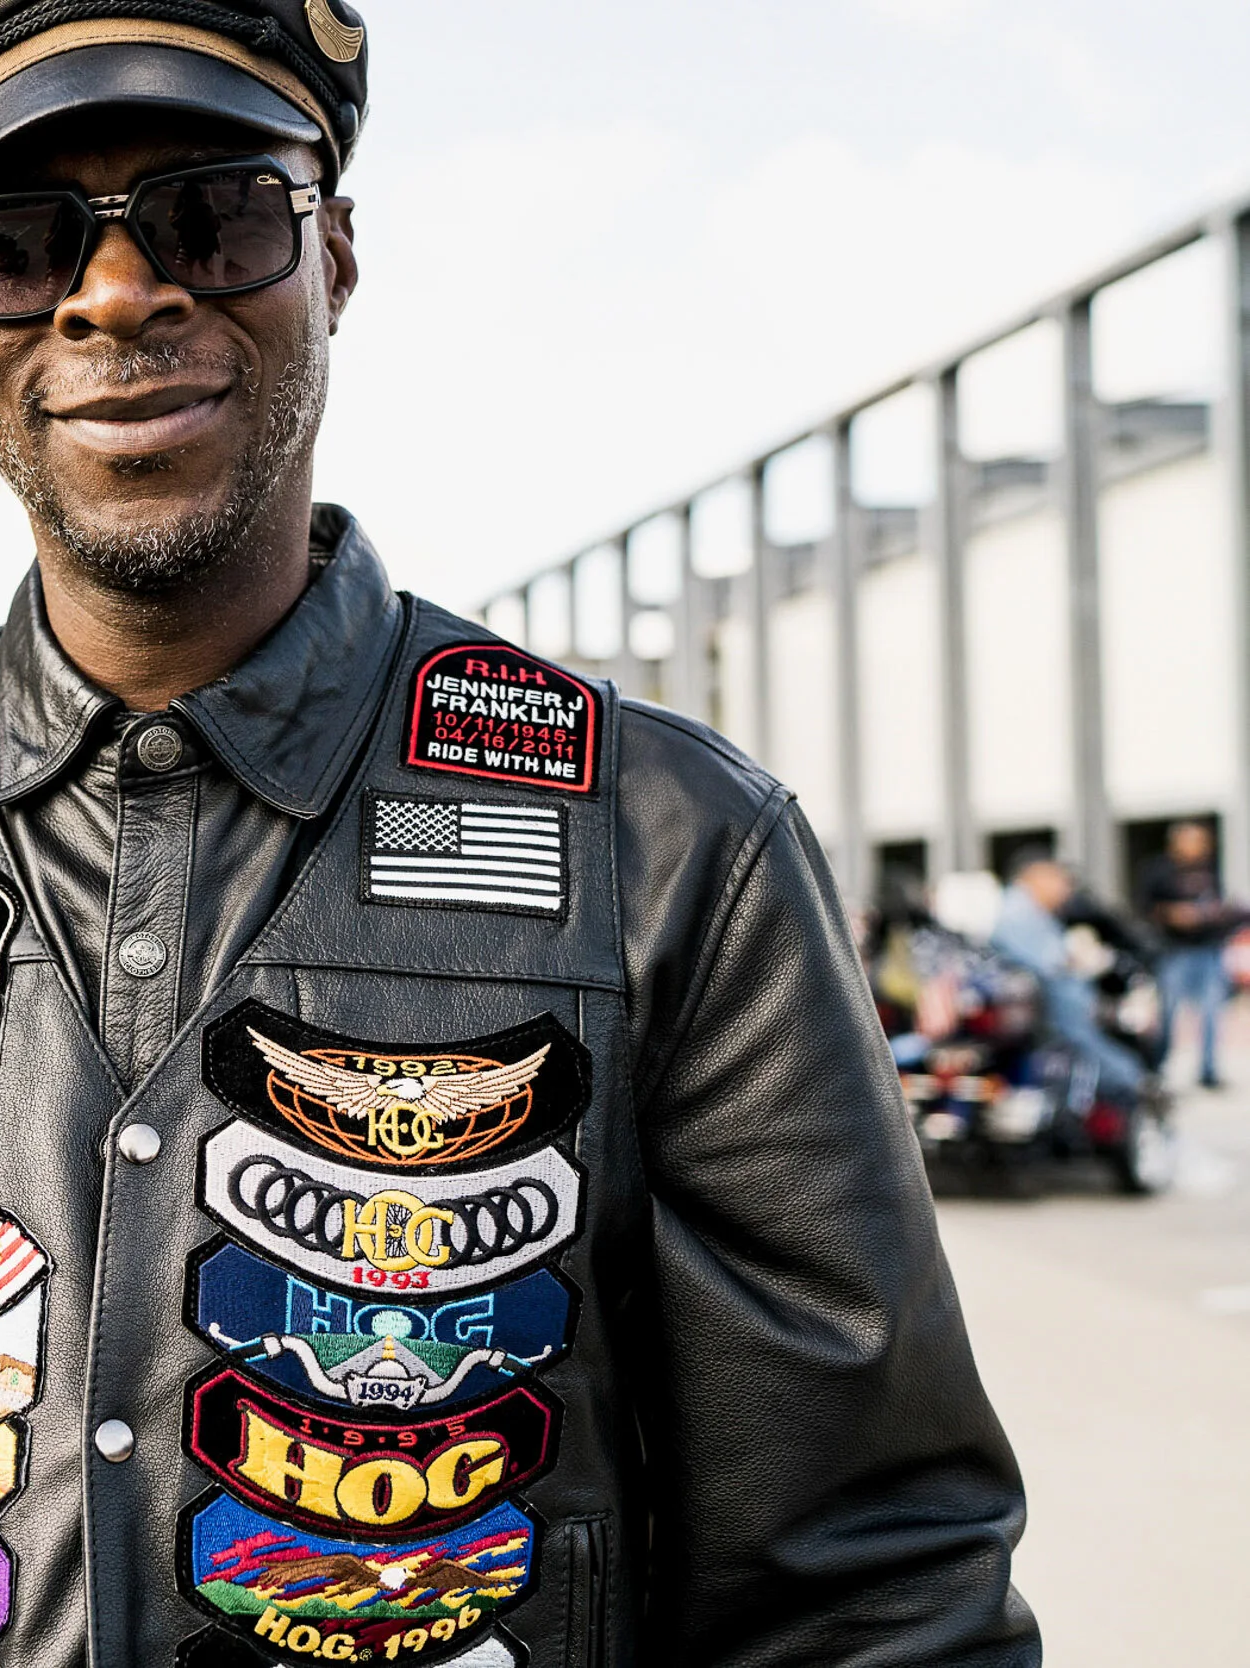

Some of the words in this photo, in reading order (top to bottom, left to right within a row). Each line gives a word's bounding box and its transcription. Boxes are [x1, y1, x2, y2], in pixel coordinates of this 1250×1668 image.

[426, 673, 562, 708] JENNIFER
[567, 695, 584, 711] J
[431, 692, 575, 729] FRANKLIN
[427, 742, 479, 764] RIDE
[484, 749, 540, 773] WITH
[544, 759, 577, 779] ME
[434, 727, 574, 760] 04/16/2011
[351, 1055, 458, 1077] 1992
[367, 1103, 446, 1155] HOG
[341, 1189, 455, 1272] HOG
[351, 1266, 431, 1290] 1993
[285, 1275, 495, 1347] HOG
[357, 1381, 415, 1403] 1994
[383, 1605, 482, 1661] 1996
